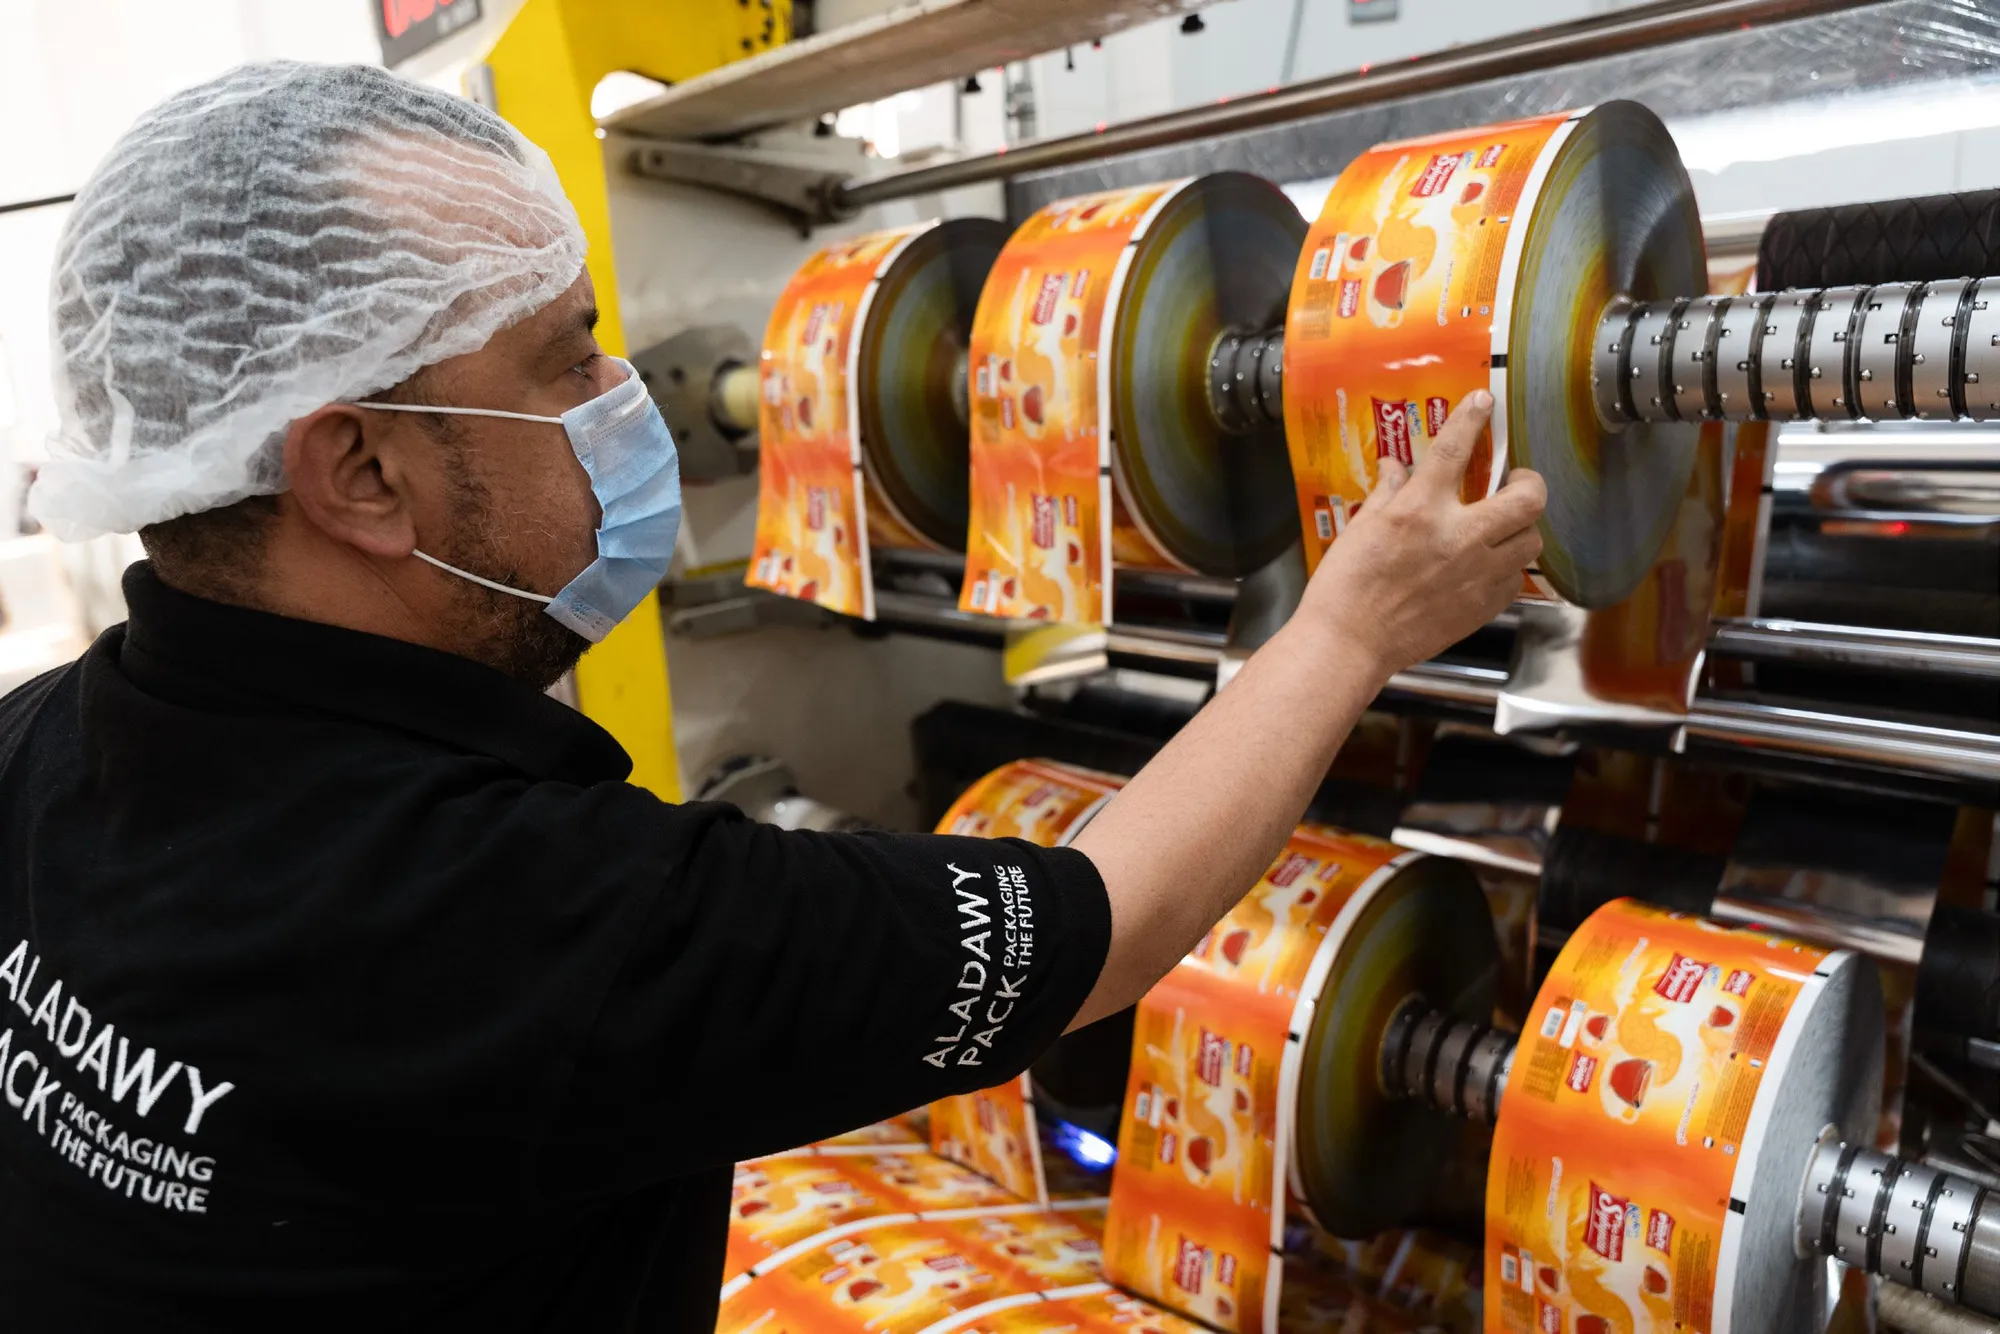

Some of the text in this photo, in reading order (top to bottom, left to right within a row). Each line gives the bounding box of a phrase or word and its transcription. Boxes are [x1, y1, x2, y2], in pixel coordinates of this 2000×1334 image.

[922, 862, 992, 1069] ALADAWY
[993, 864, 1018, 967] PACKAGING
[1007, 865, 1035, 969] THE FUTURE
[0, 939, 235, 1135] ALADAWY
[957, 974, 1028, 1067] PACK
[51, 1119, 209, 1213] THE FUTURE
[60, 1092, 216, 1182] PACKAGING
